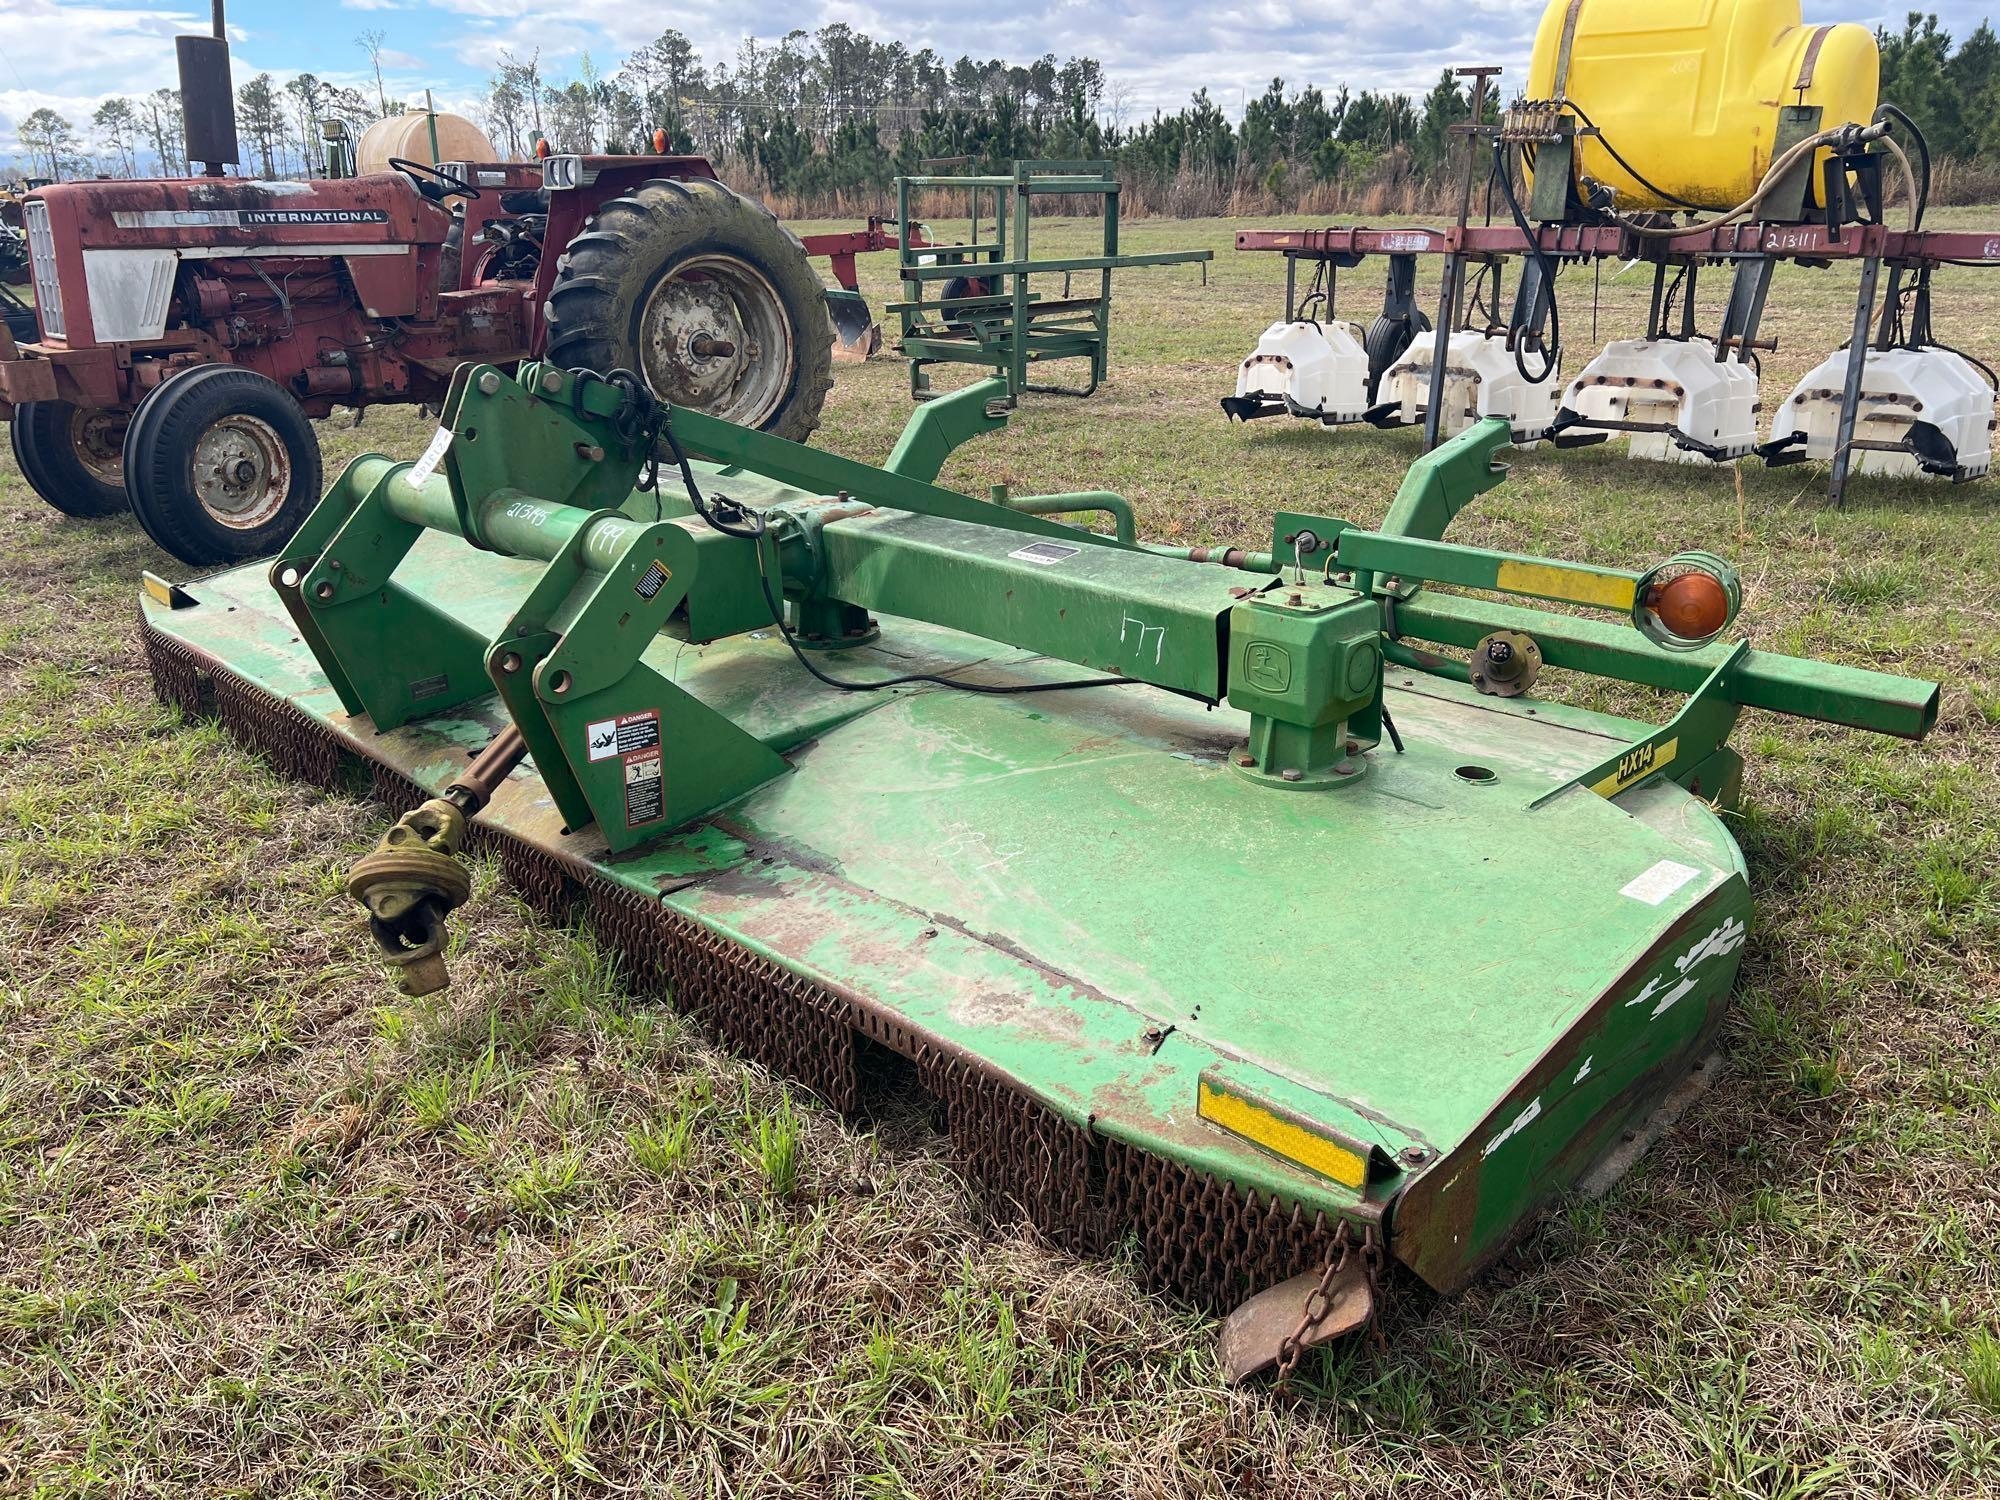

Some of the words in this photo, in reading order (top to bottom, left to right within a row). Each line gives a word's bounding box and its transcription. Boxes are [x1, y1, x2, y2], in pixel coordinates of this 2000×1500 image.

[247, 211, 382, 223] INTERNATIONAL
[506, 502, 552, 526] 213145
[589, 521, 625, 555] 199
[627, 712, 653, 723] DANGER
[632, 750, 660, 762] DANGER
[1616, 742, 1655, 784] HX14
